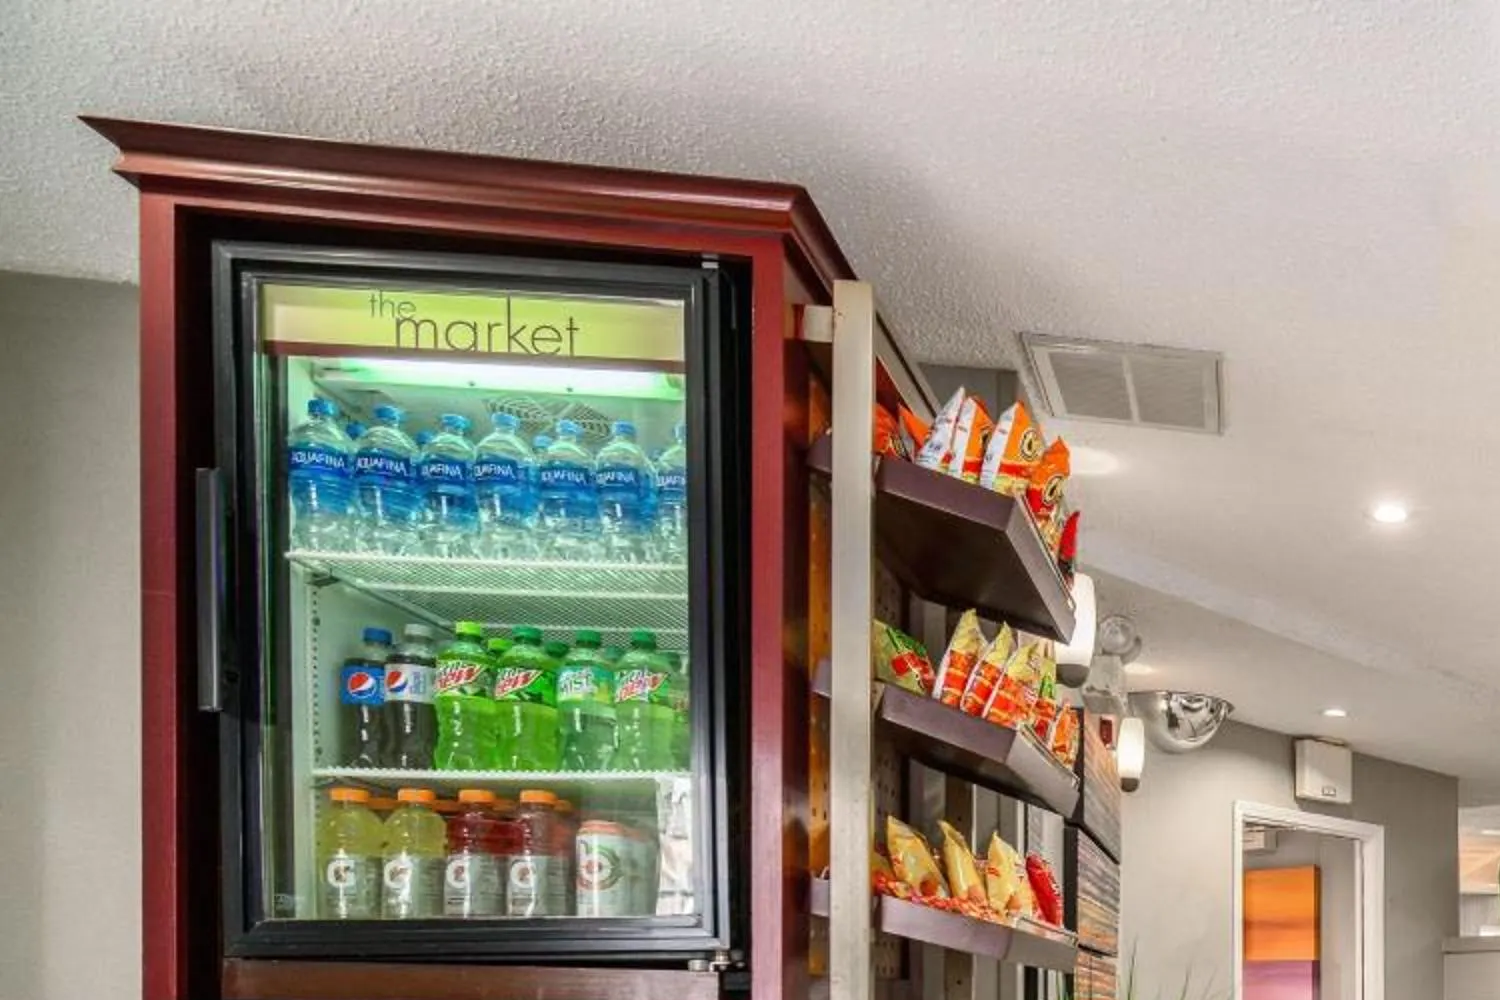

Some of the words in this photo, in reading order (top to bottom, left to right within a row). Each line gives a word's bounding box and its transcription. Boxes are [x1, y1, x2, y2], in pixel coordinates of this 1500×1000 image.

[369, 289, 416, 319] the
[395, 296, 580, 357] market
[290, 450, 346, 469] AQUAFINA
